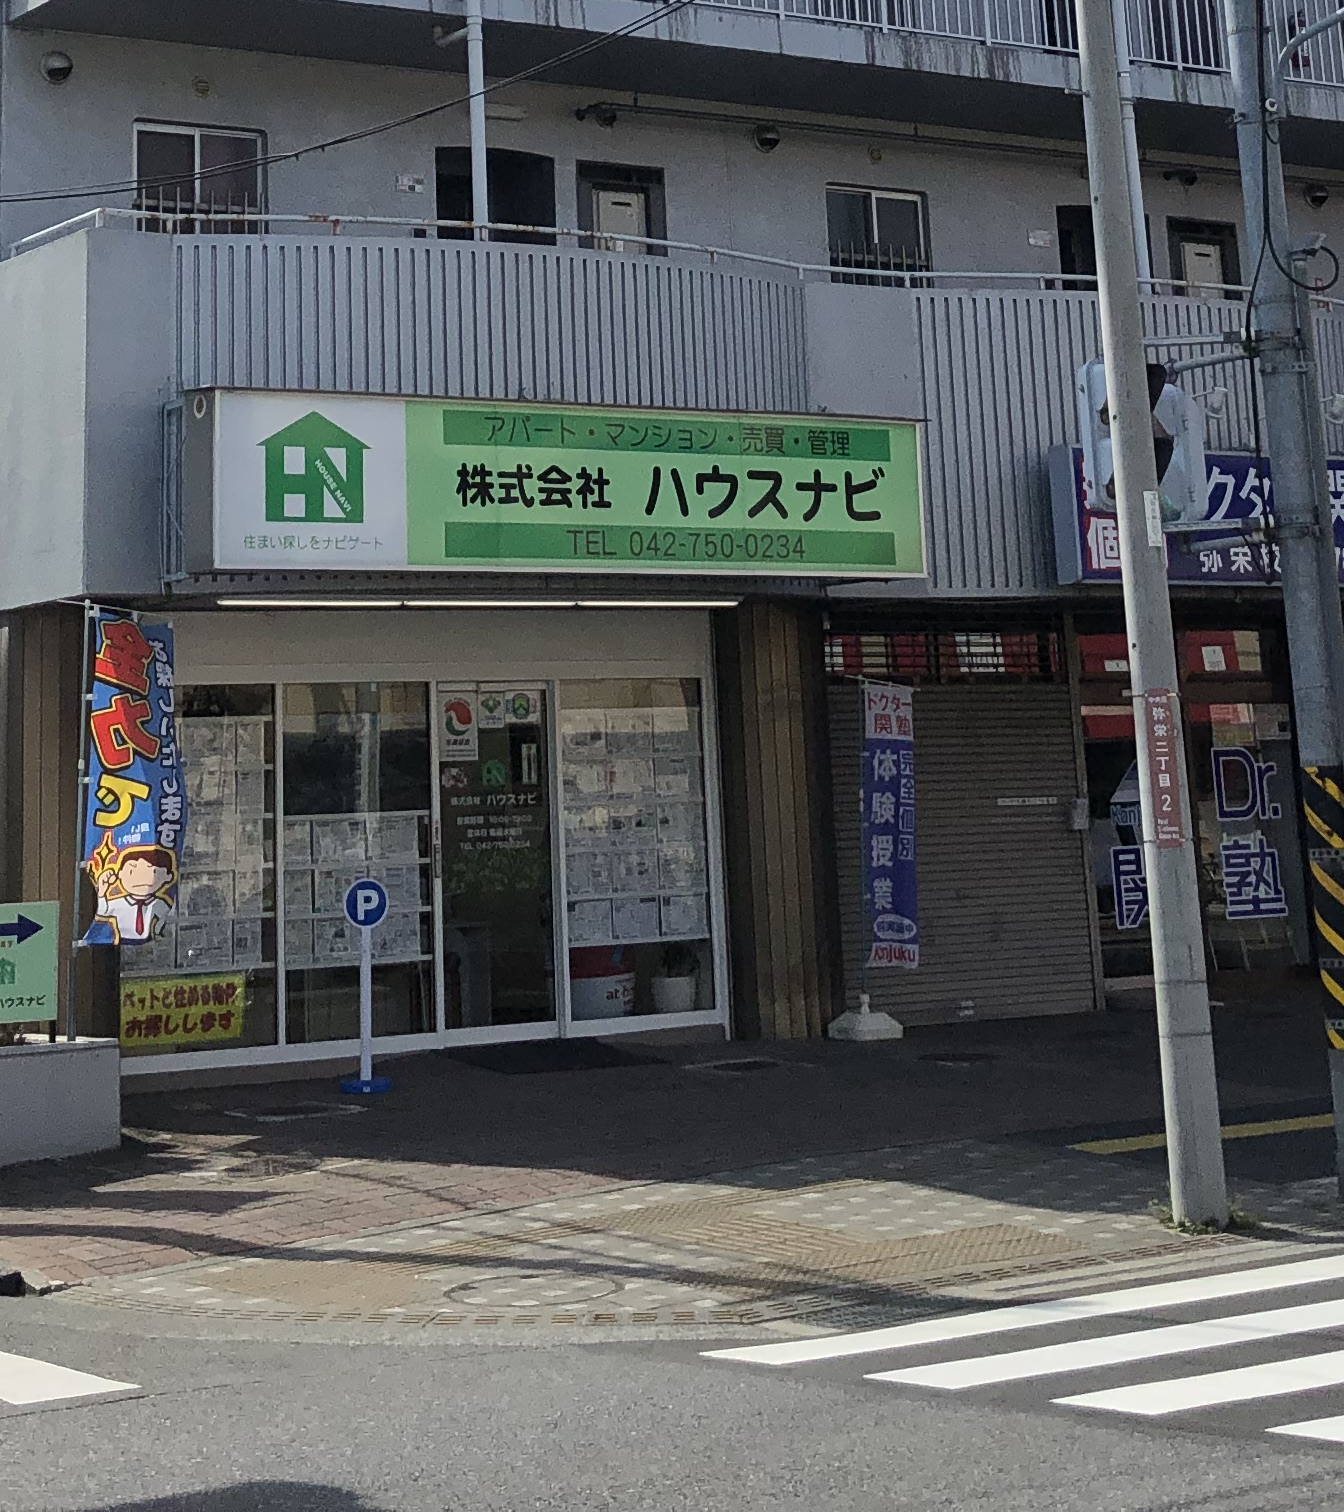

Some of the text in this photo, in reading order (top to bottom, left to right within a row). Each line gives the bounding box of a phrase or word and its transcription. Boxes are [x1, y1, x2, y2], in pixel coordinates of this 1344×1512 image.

[314, 458, 353, 513] HOUSE NAVI
[456, 462, 884, 523] 株式会社 ハウスナビ
[567, 529, 806, 561] TEL 042-750-0234
[1152, 706, 1171, 788] 弥栄二丁目
[486, 793, 537, 806] ハウスナビ
[1161, 794, 1172, 812] 2
[1211, 746, 1281, 820] Dr.
[357, 889, 379, 921] P
